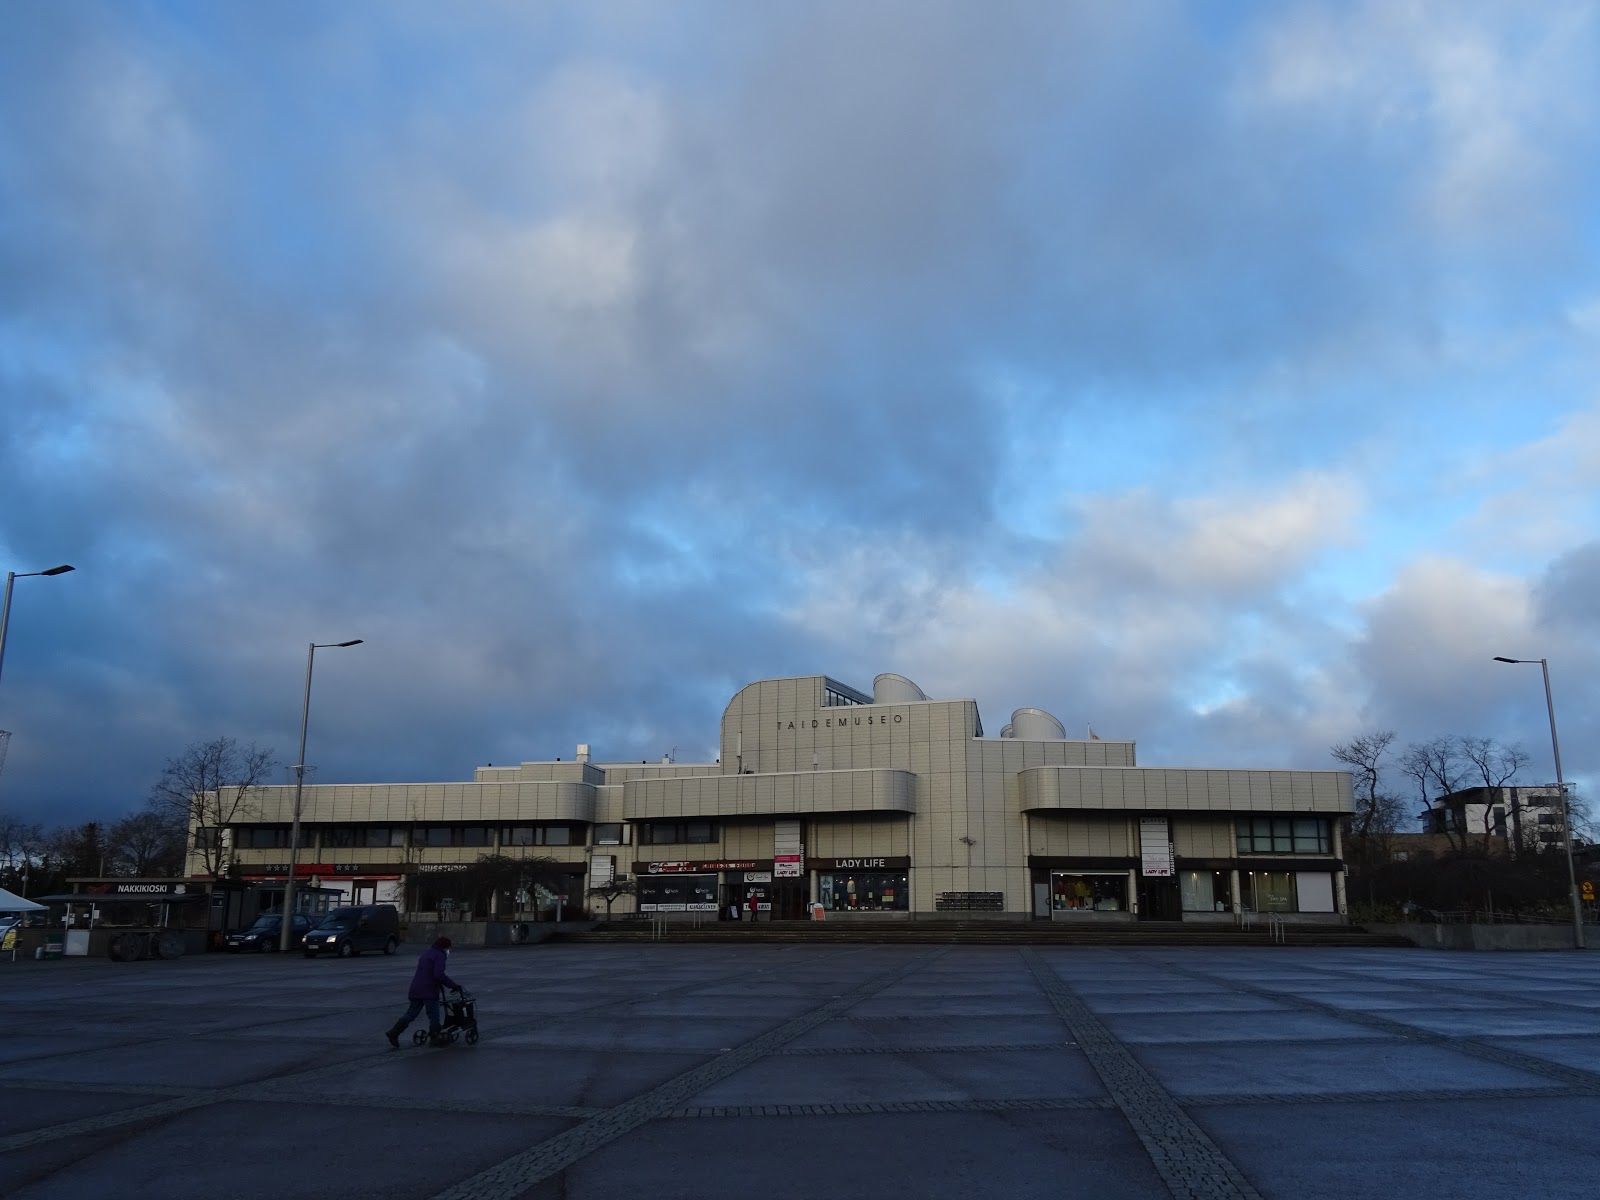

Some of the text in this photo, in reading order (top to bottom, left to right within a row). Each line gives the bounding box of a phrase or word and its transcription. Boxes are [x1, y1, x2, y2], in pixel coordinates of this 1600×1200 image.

[777, 714, 902, 730] TAIDEMUSEO
[835, 858, 885, 868] LADY LIFE
[117, 884, 167, 893] NAKKIKIOSKI
